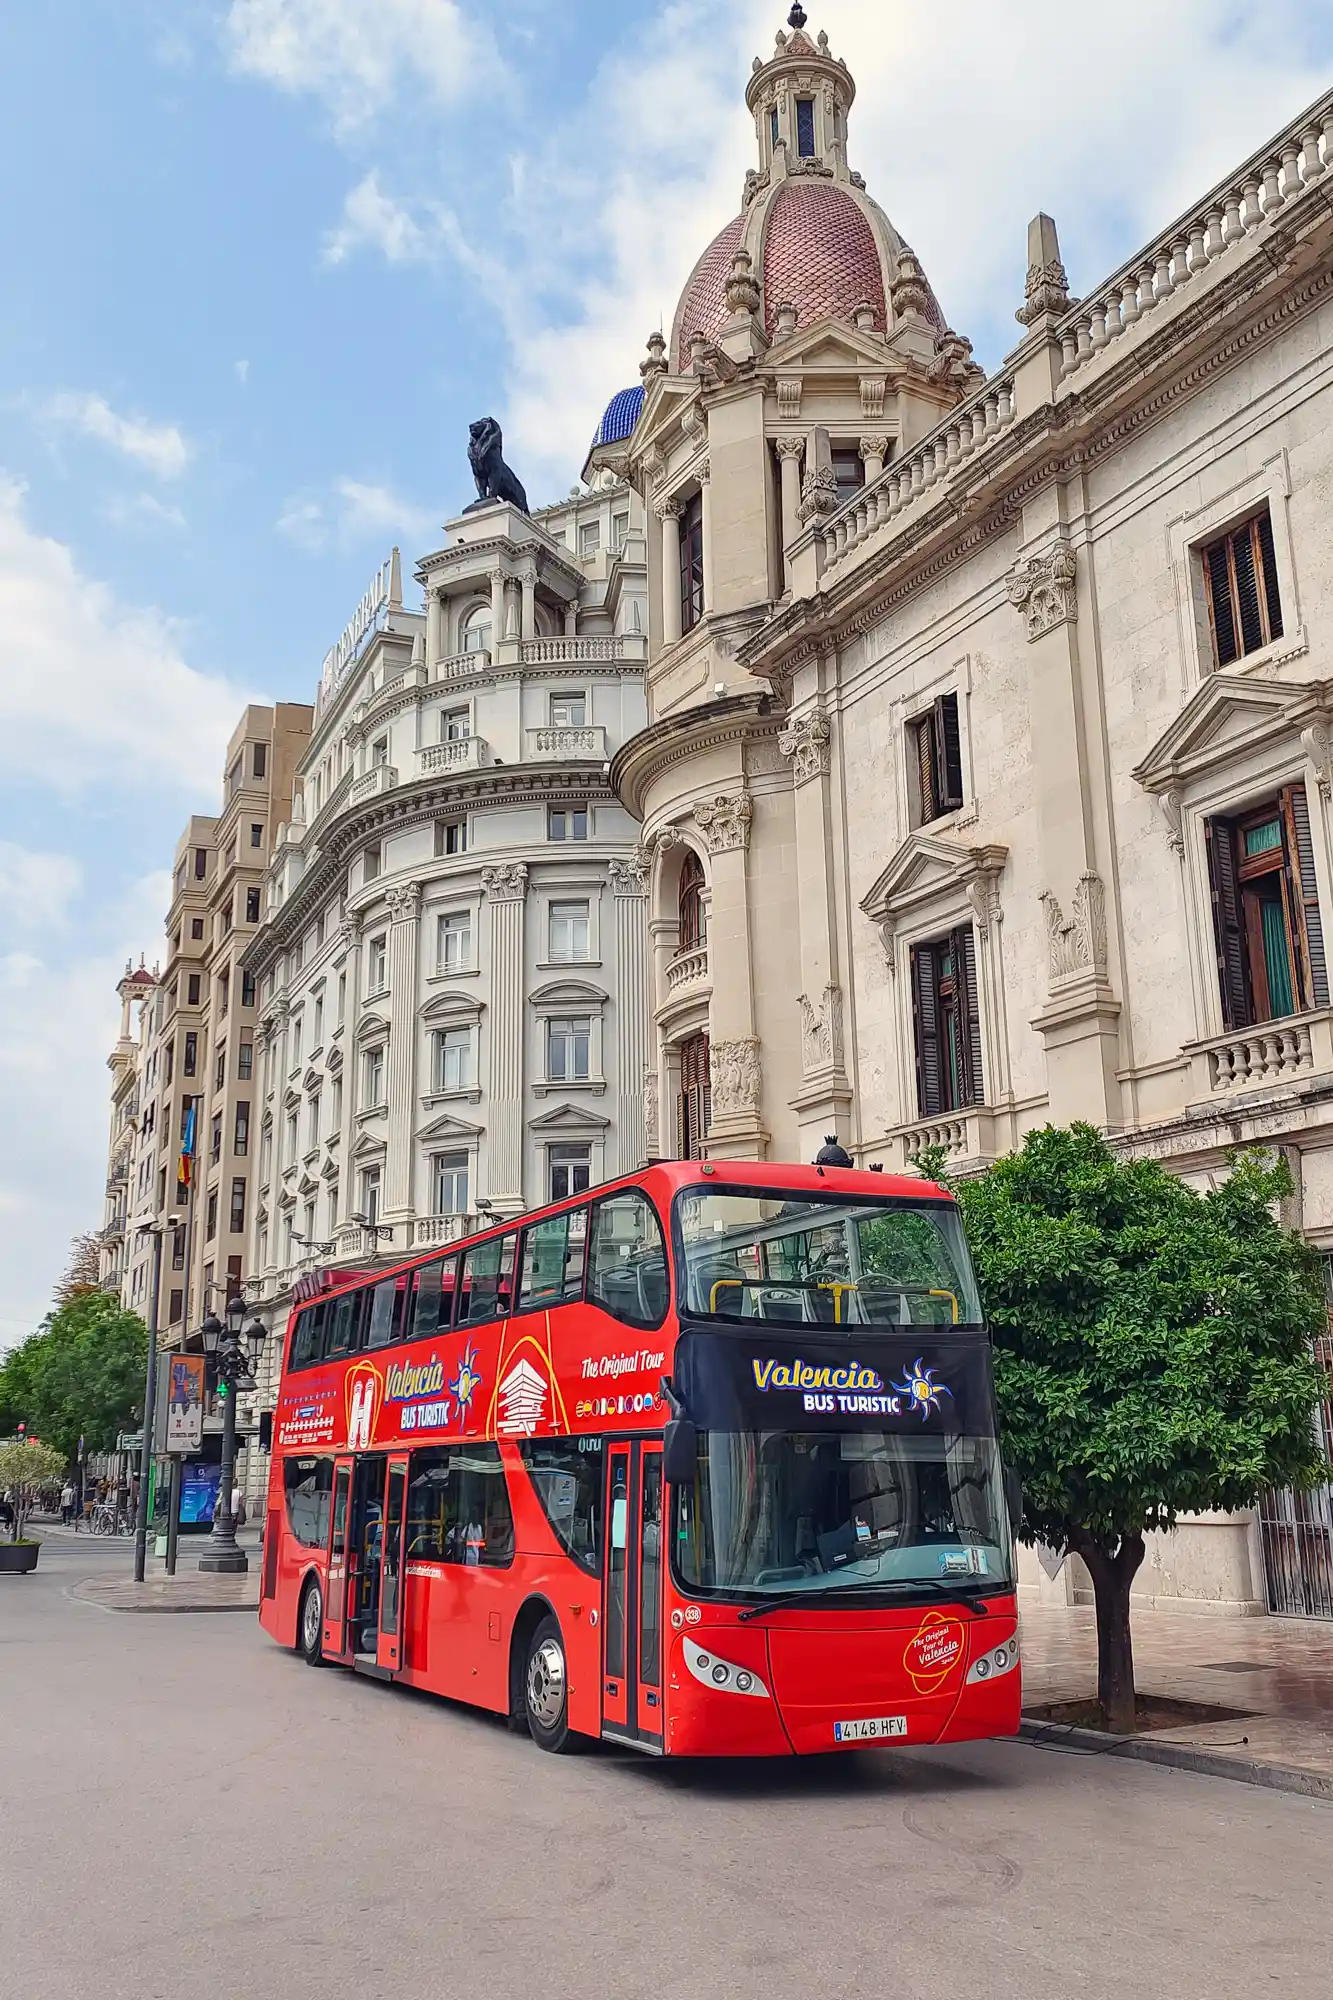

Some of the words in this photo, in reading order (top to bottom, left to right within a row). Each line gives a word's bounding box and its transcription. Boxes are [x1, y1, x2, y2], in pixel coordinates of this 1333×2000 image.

[384, 1351, 444, 1403] Valencia
[582, 1356, 599, 1379] The
[600, 1350, 639, 1380] Original
[640, 1349, 665, 1372] Tour
[752, 1358, 884, 1391] Valencia
[400, 1407, 417, 1429] BUS
[417, 1401, 450, 1428] TURISTIC
[804, 1394, 834, 1411] BUS
[838, 1395, 900, 1413] TURISTIC
[913, 1639, 925, 1649] The
[925, 1625, 949, 1642] Original
[922, 1642, 936, 1653] Tour
[937, 1636, 945, 1647] of
[918, 1640, 960, 1665] Valencia
[843, 1721, 877, 1738] 4148
[881, 1719, 904, 1736] HFV
